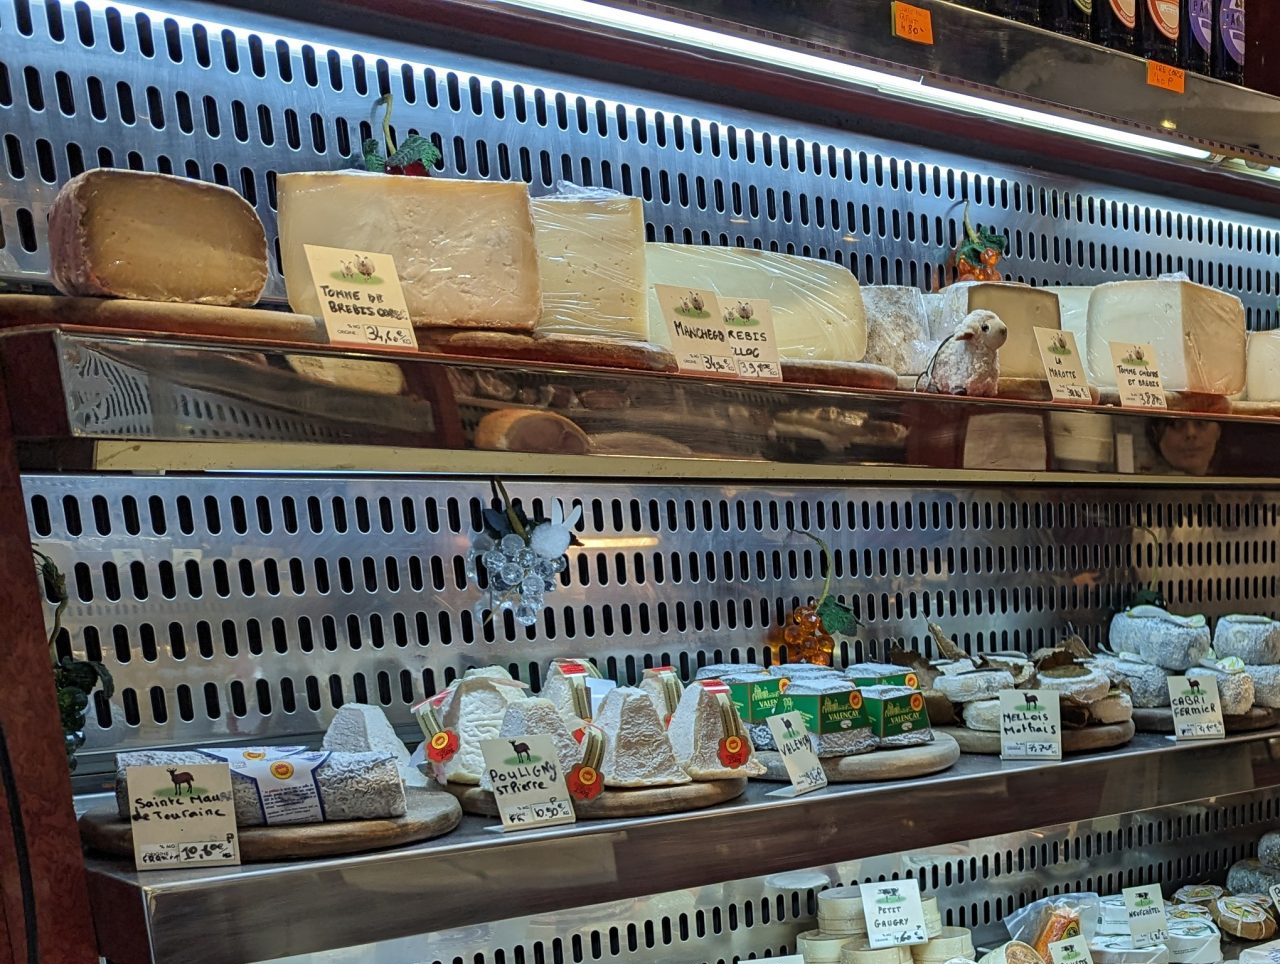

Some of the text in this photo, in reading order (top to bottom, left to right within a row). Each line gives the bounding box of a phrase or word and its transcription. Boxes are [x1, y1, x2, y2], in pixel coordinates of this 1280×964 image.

[328, 300, 375, 316] BREBIS
[673, 320, 725, 343] MANCHEGO
[727, 331, 768, 341] REBIS
[1172, 696, 1206, 706] CABRI
[828, 710, 860, 721] VALENÇAY
[890, 712, 921, 724] VALENÇAY
[135, 798, 185, 810] Sainte
[878, 905, 902, 915] PETIT
[874, 917, 909, 928] GAUGRY
